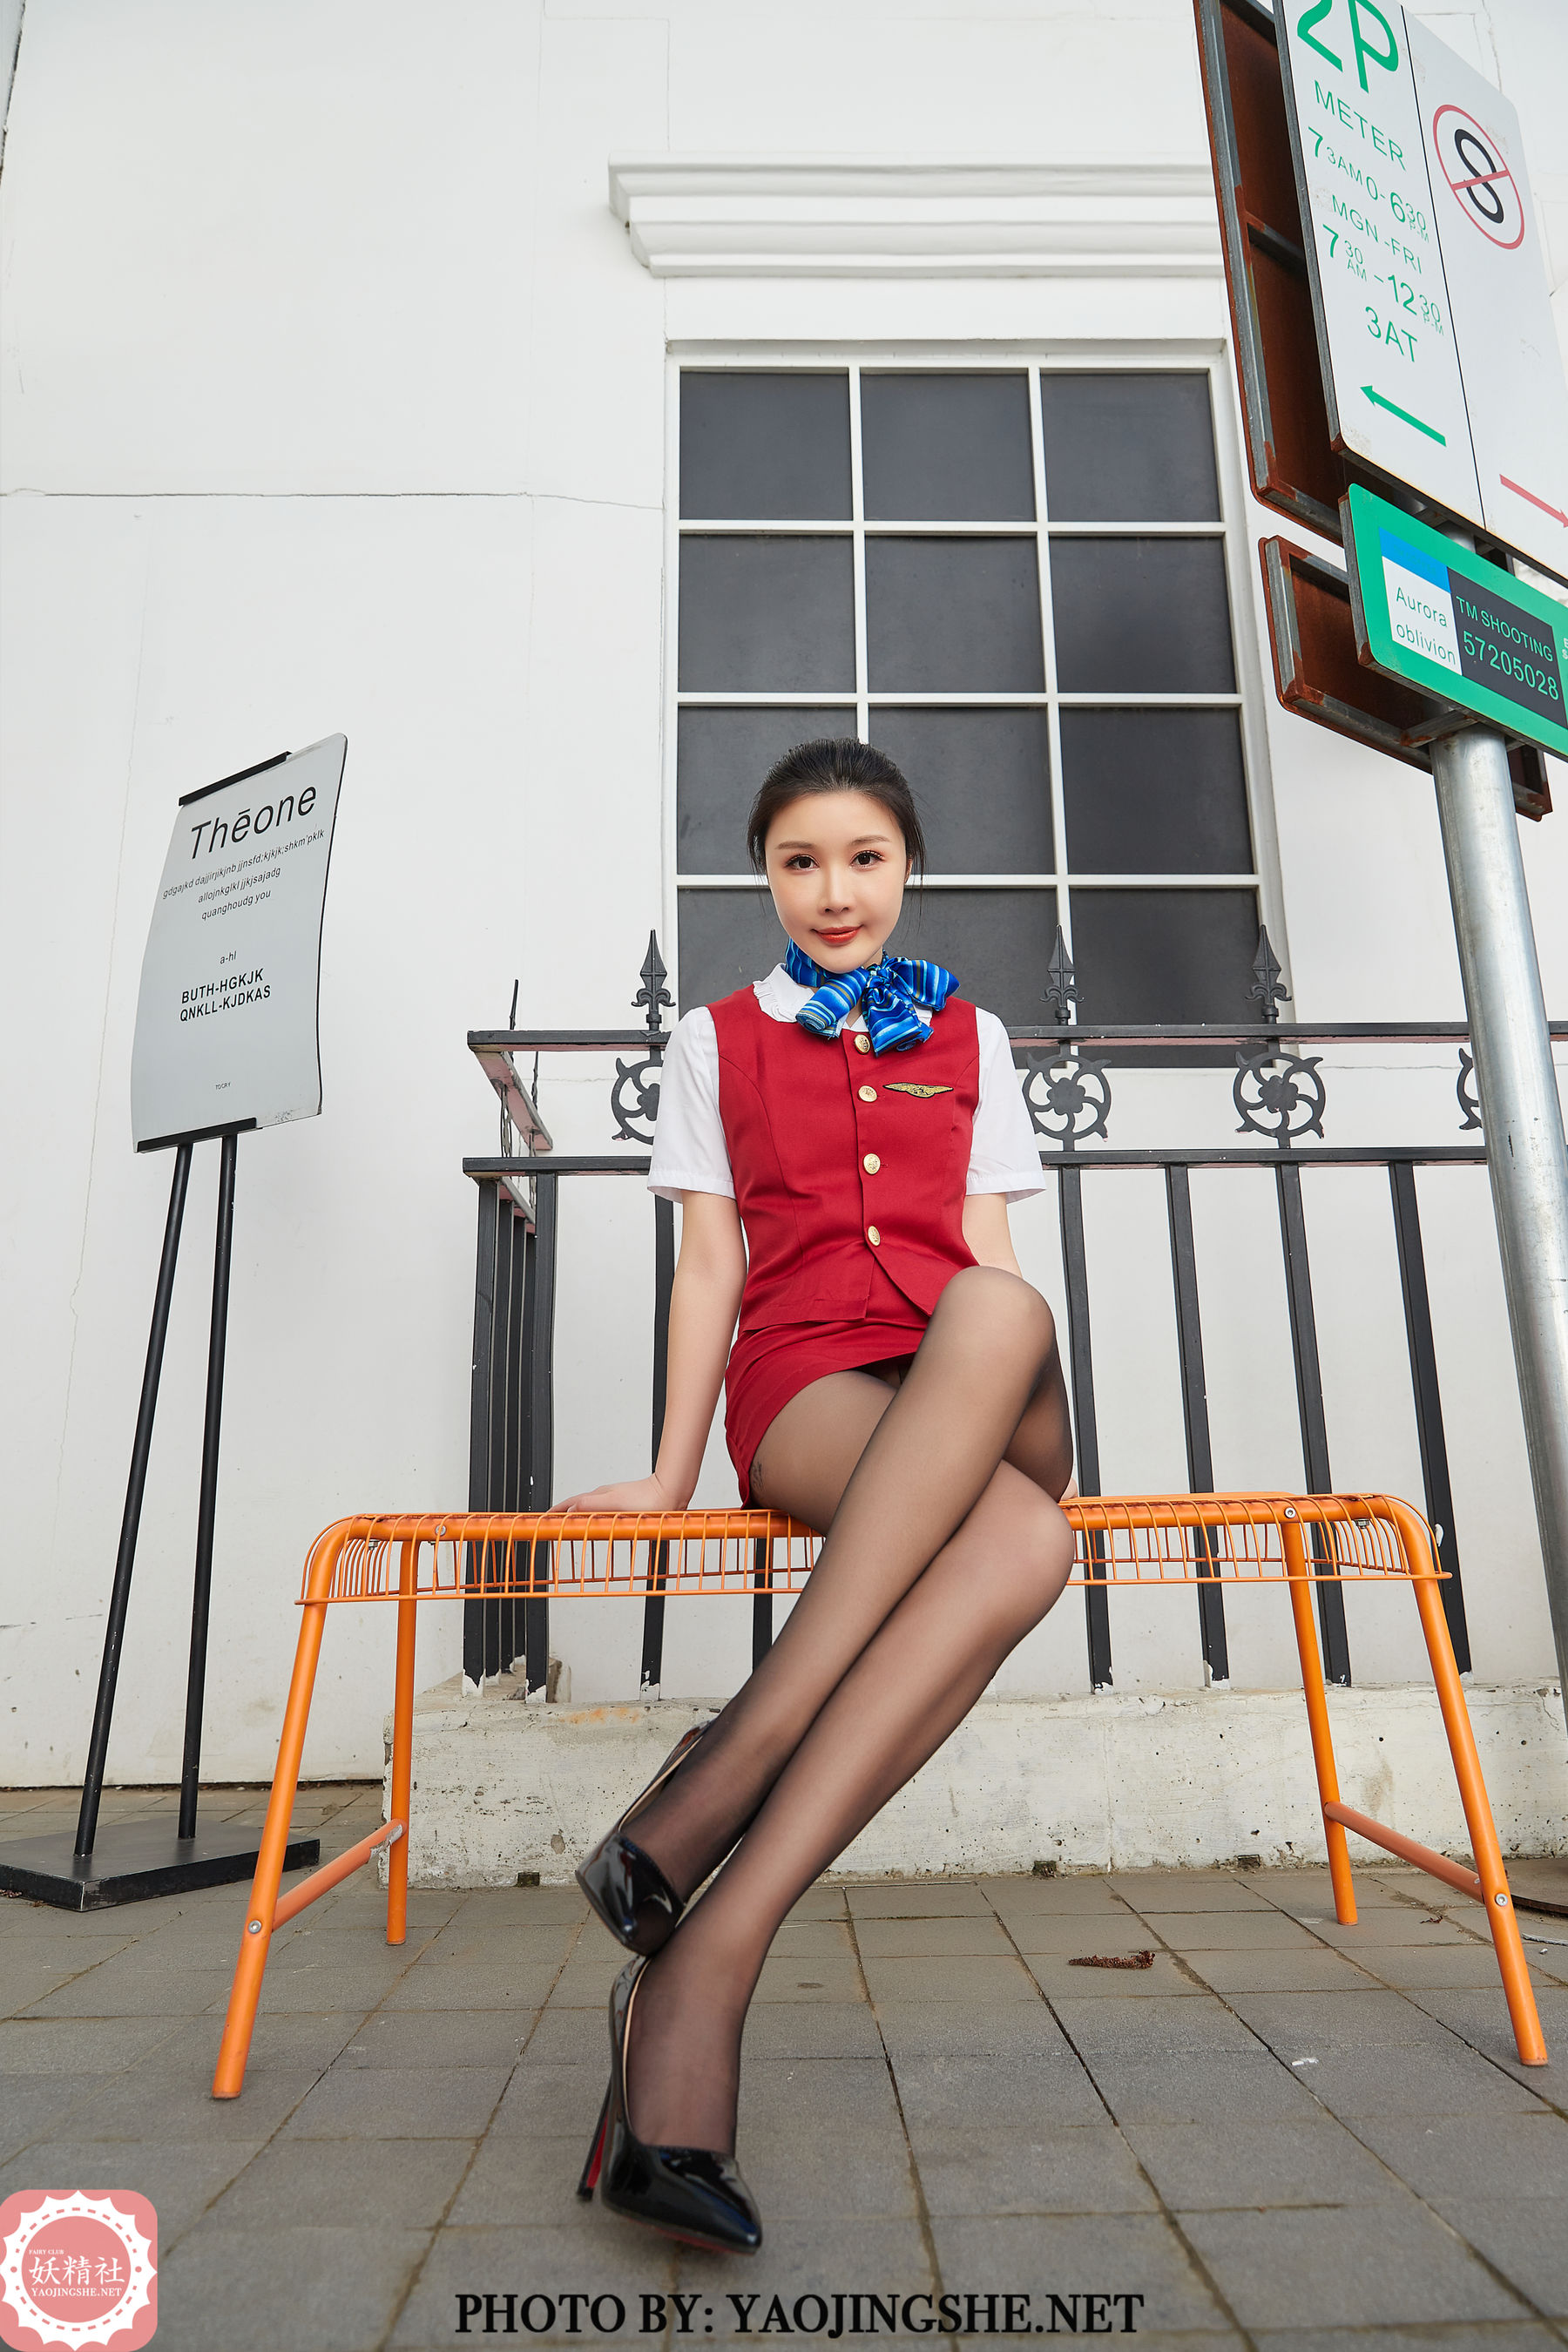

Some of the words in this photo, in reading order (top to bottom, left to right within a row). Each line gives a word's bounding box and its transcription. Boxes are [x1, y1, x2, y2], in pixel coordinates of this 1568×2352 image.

[1315, 80, 1406, 172] METER
[1365, 307, 1418, 362] 3AT
[1396, 586, 1447, 627] Aurora
[1396, 624, 1456, 665] oblivion
[1456, 595, 1478, 621] TM
[1481, 610, 1553, 662] SHOOTING
[1463, 630, 1559, 700] 57205028
[201, 895, 253, 922] quanghoudg
[254, 889, 272, 904] you
[179, 984, 271, 1022] QNKLL-KJDKAS
[181, 968, 264, 1004] BUTH-HGKJK
